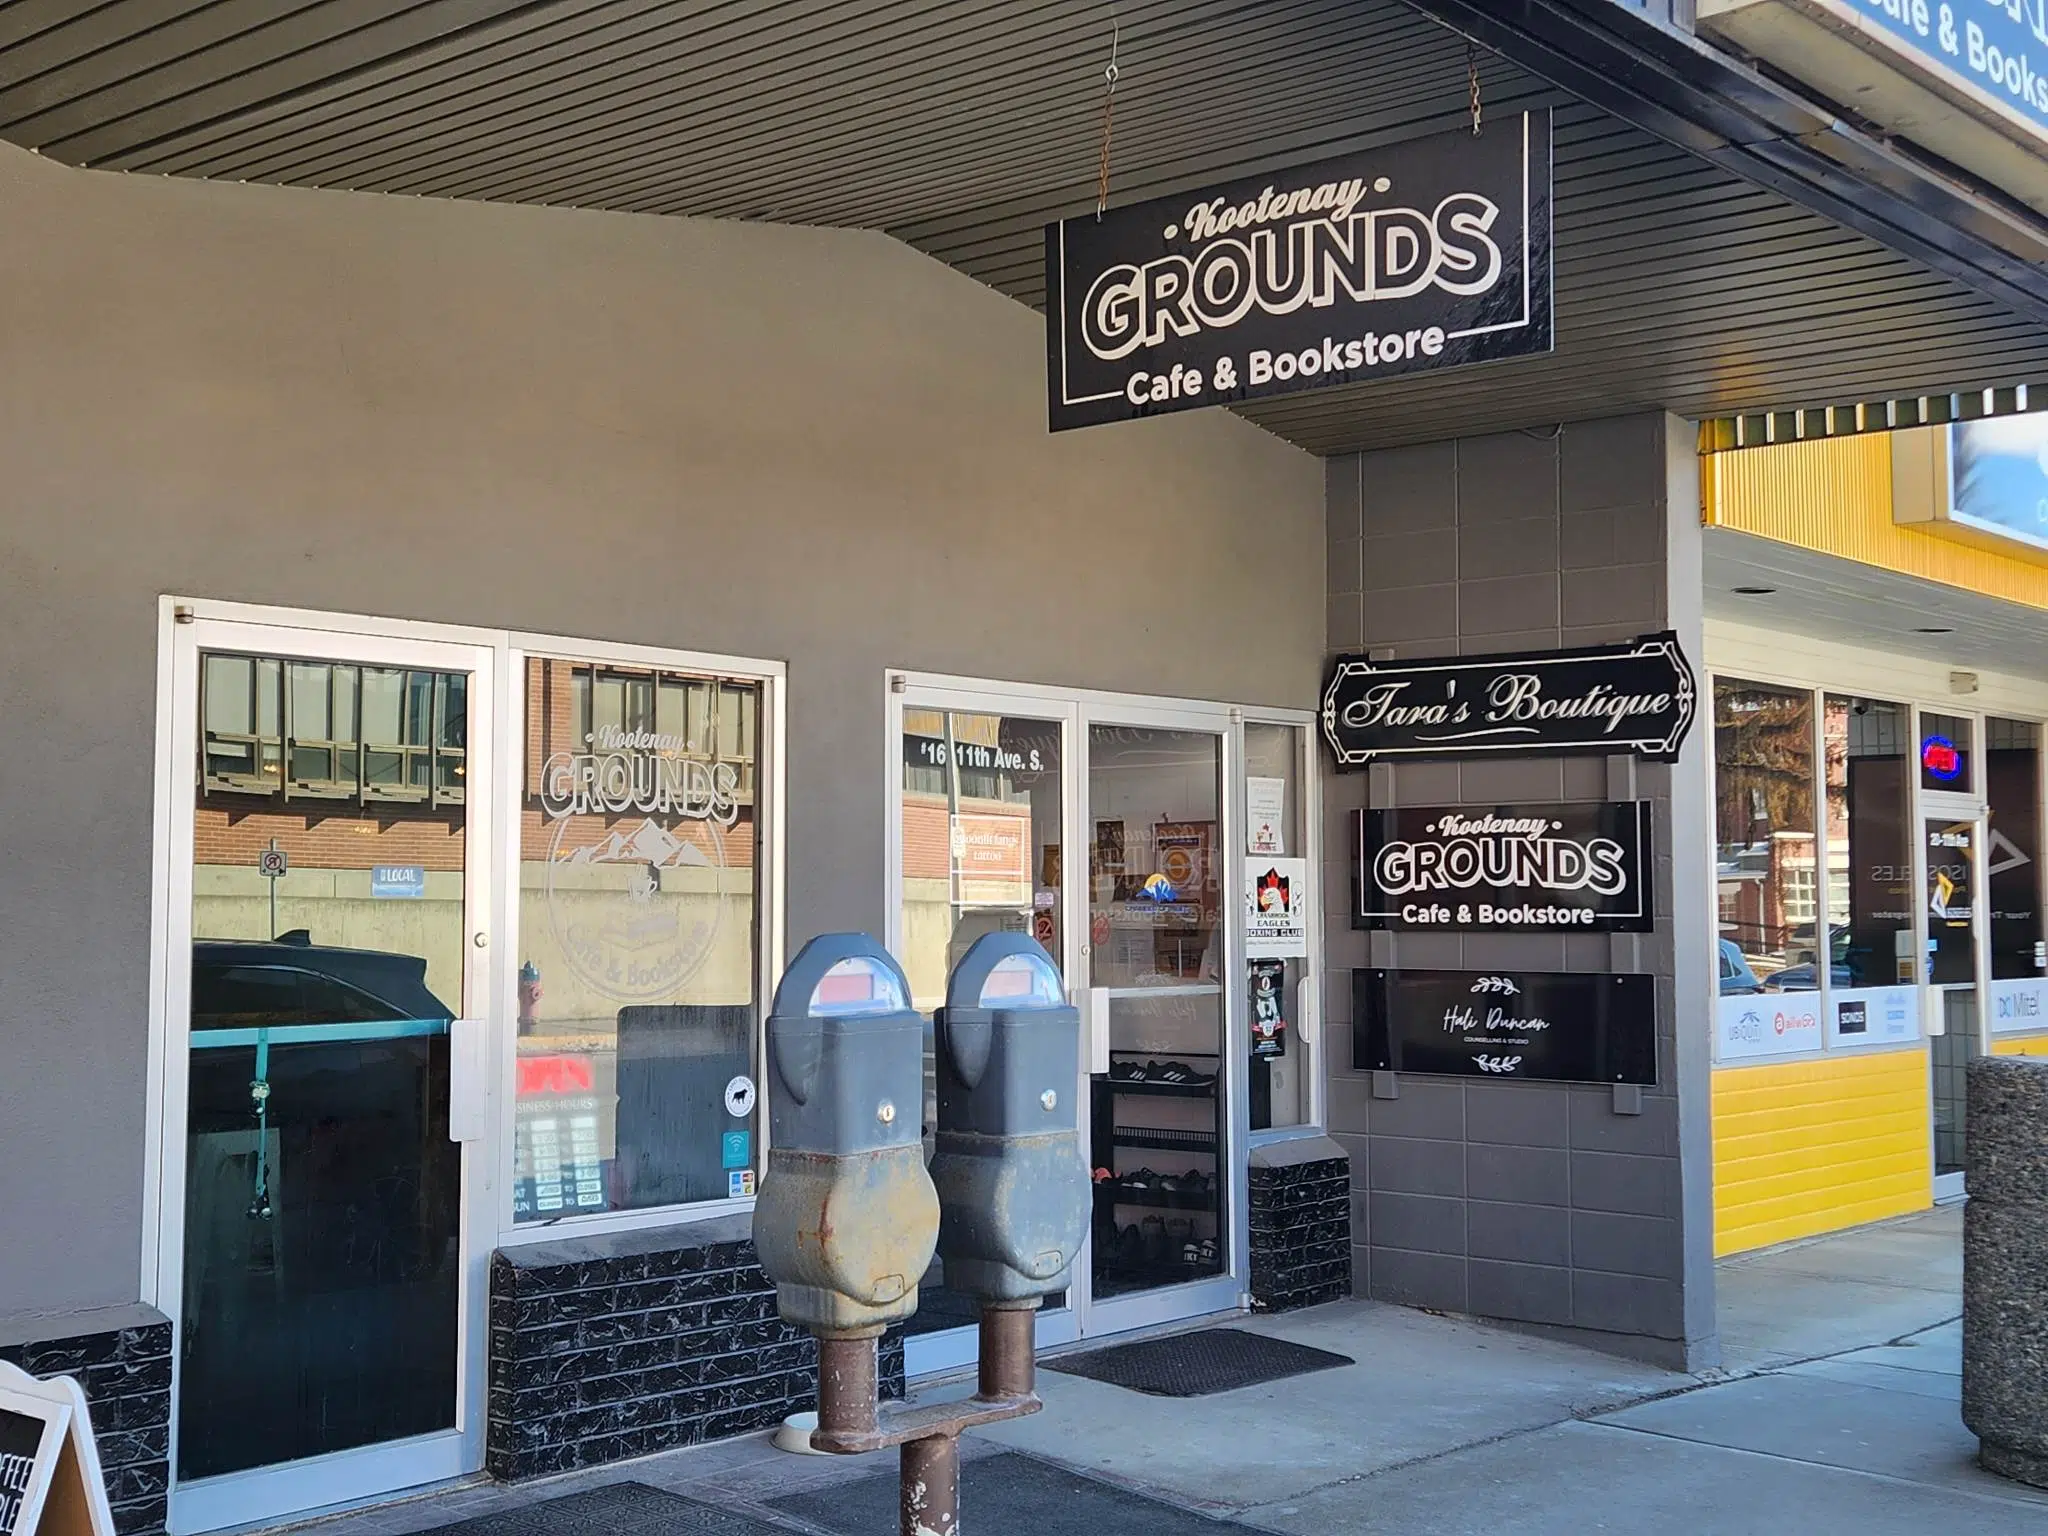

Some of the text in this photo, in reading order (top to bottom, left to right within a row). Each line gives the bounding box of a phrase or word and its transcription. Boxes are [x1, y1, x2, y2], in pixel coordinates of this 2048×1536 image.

[1868, 0, 1930, 37] afe
[1939, 3, 1960, 56] &
[1184, 176, 1367, 242] Kootenay
[1081, 192, 1502, 360] GROUNDS
[1126, 326, 1445, 405] Cafe & Bookstore
[1342, 674, 1672, 734] Tara's Boutique
[599, 723, 685, 760] Kootenay
[956, 747, 990, 768] 11th
[994, 750, 1026, 770] Ave.
[1029, 749, 1044, 772] S.
[540, 751, 738, 826] GROUNDS
[1438, 814, 1549, 841] Kootenay
[387, 869, 416, 881] LOCAL
[1374, 838, 1626, 895] GROUNDS
[1402, 903, 1595, 925] Cafe & Bookstore
[1443, 1004, 1550, 1033] Hali Duncan
